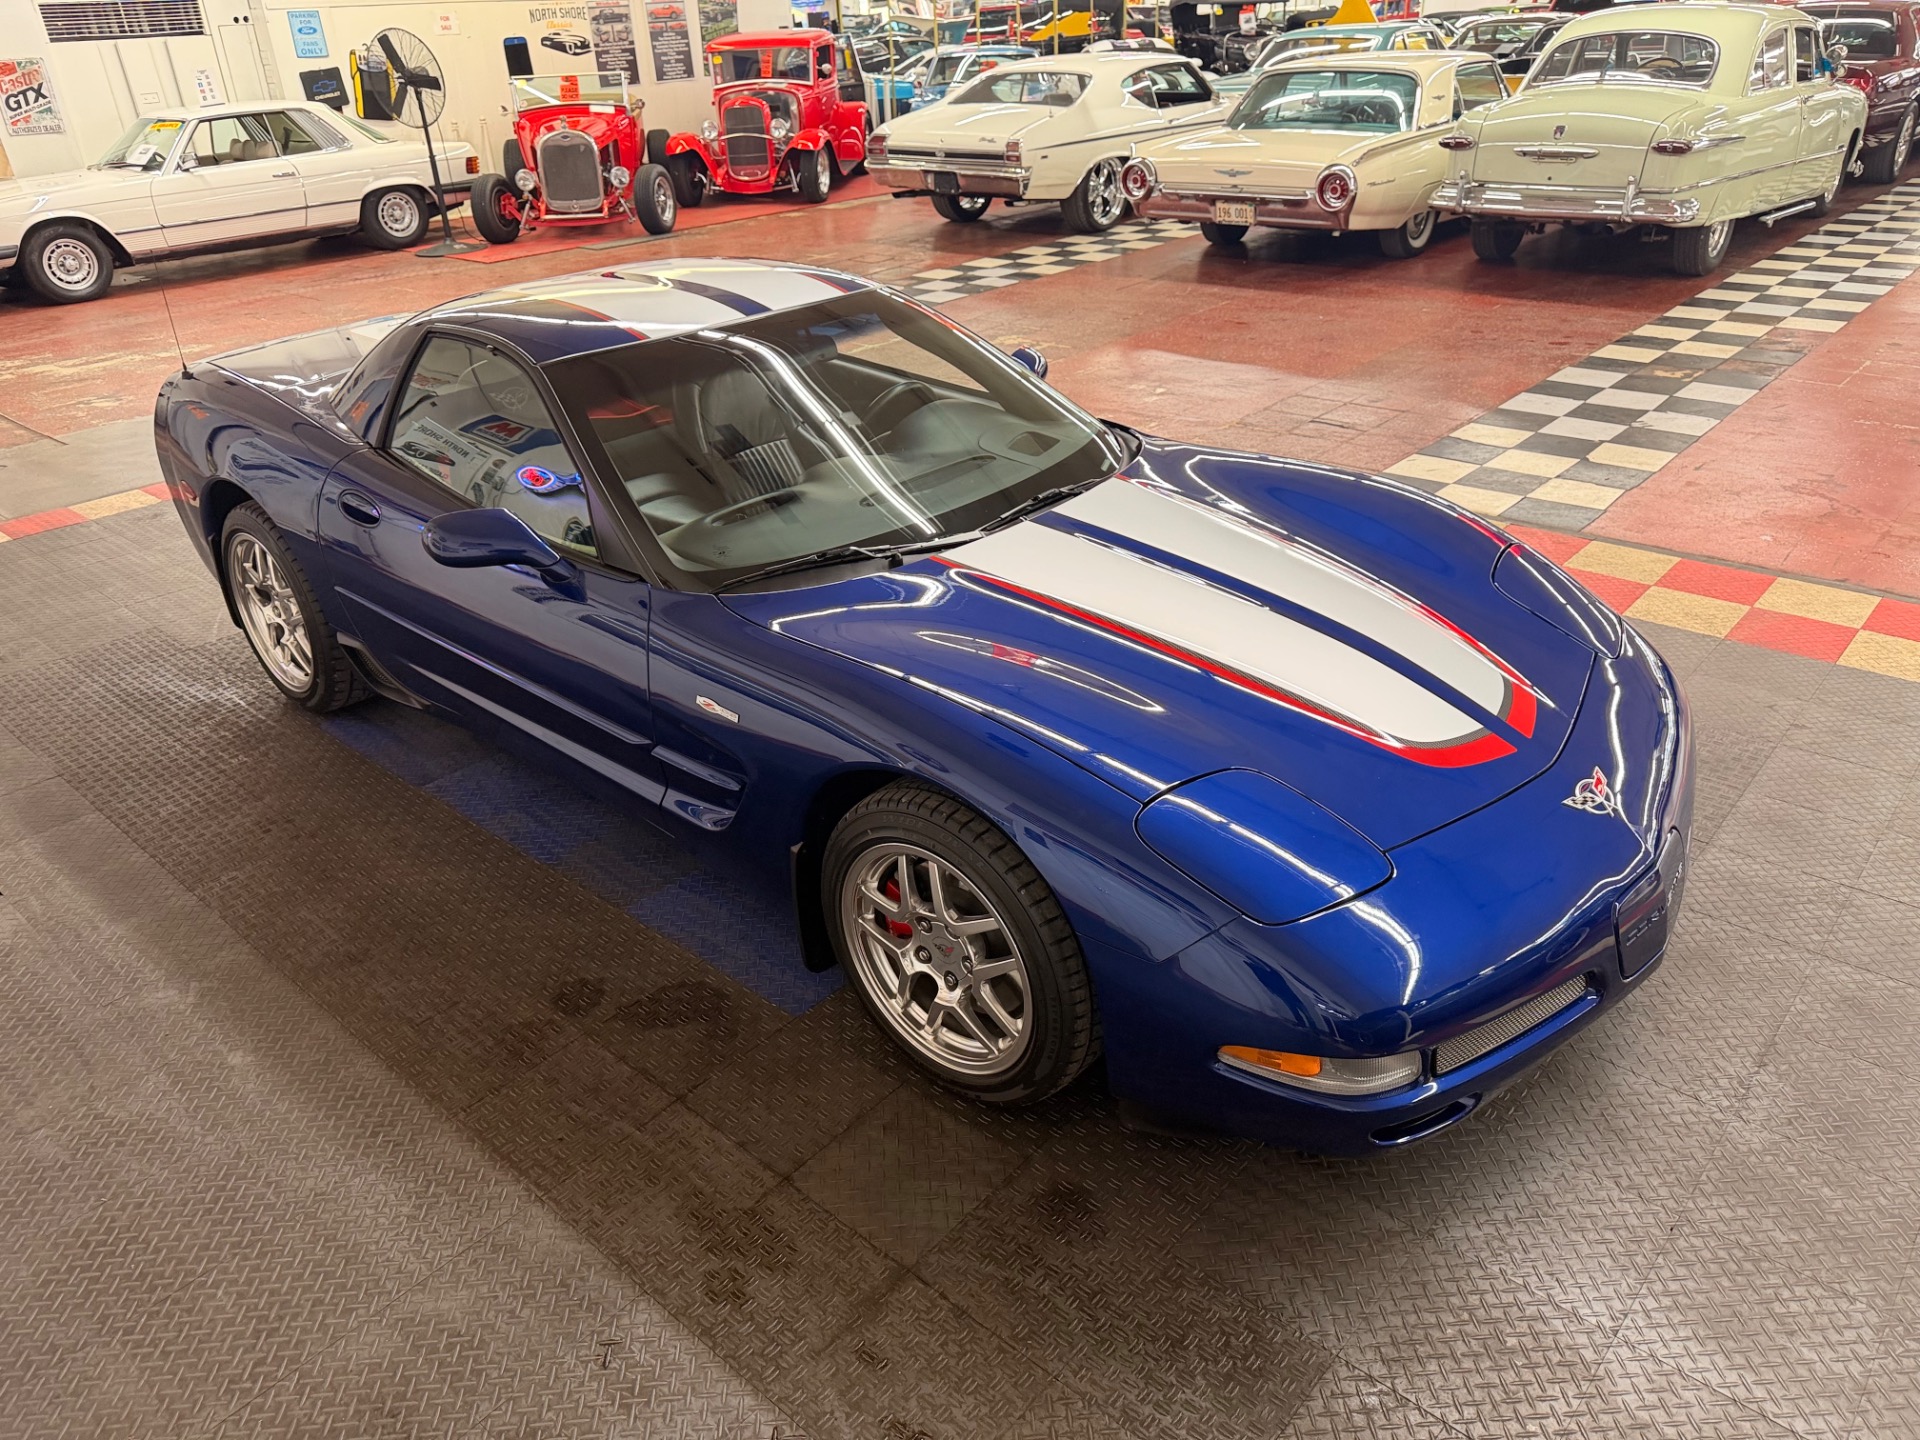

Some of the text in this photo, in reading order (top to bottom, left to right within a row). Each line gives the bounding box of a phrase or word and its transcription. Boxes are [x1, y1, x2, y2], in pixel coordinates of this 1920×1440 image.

[529, 7, 588, 23] NORTH SHORE
[300, 47, 323, 55] ONLY
[4, 82, 49, 112] GTX
[314, 91, 341, 100] CHEVROLET
[12, 124, 62, 134] AUTHORIZED DEALER
[1218, 207, 1248, 219] 196 001
